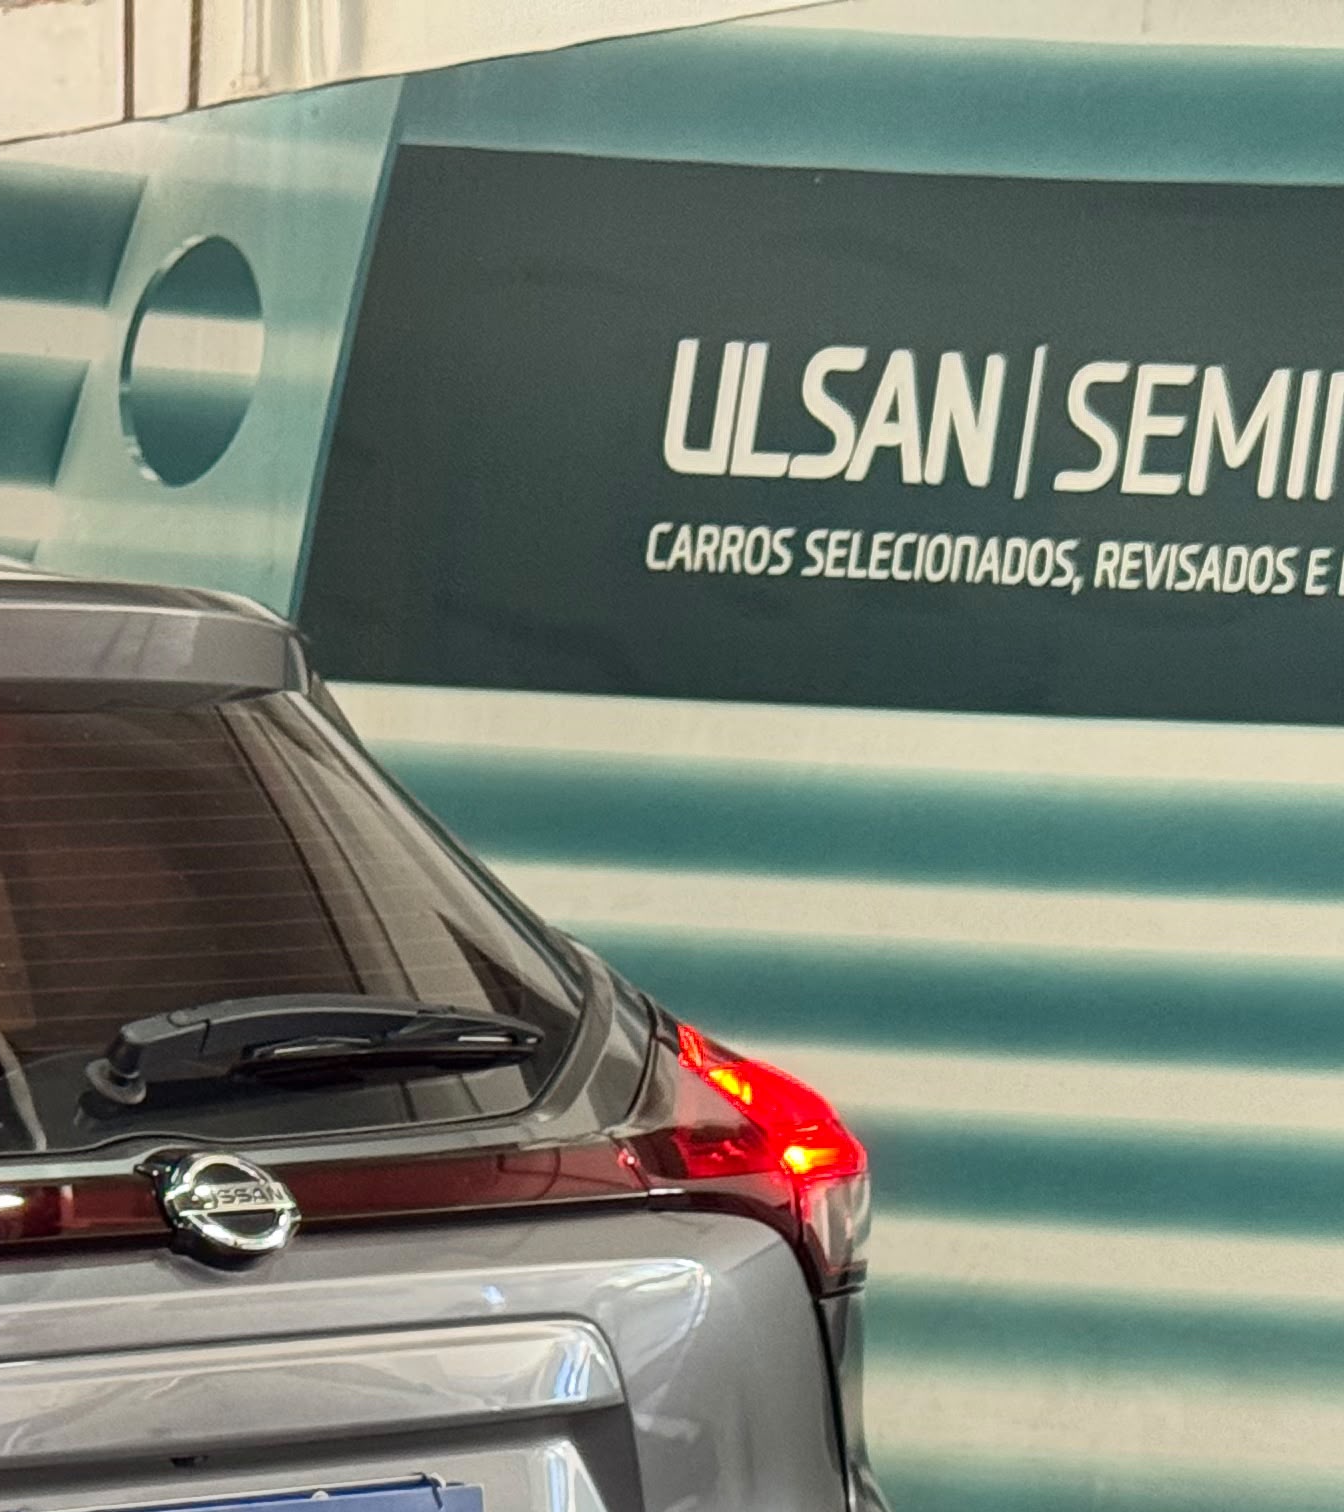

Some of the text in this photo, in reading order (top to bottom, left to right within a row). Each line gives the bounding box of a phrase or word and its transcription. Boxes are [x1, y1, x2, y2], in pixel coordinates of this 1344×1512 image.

[663, 337, 1007, 488] ULSAN
[646, 522, 796, 576] CARROS
[801, 529, 1085, 596] SELECIONADOS,
[1093, 541, 1299, 596] REVISADOS
[1304, 547, 1335, 597] E
